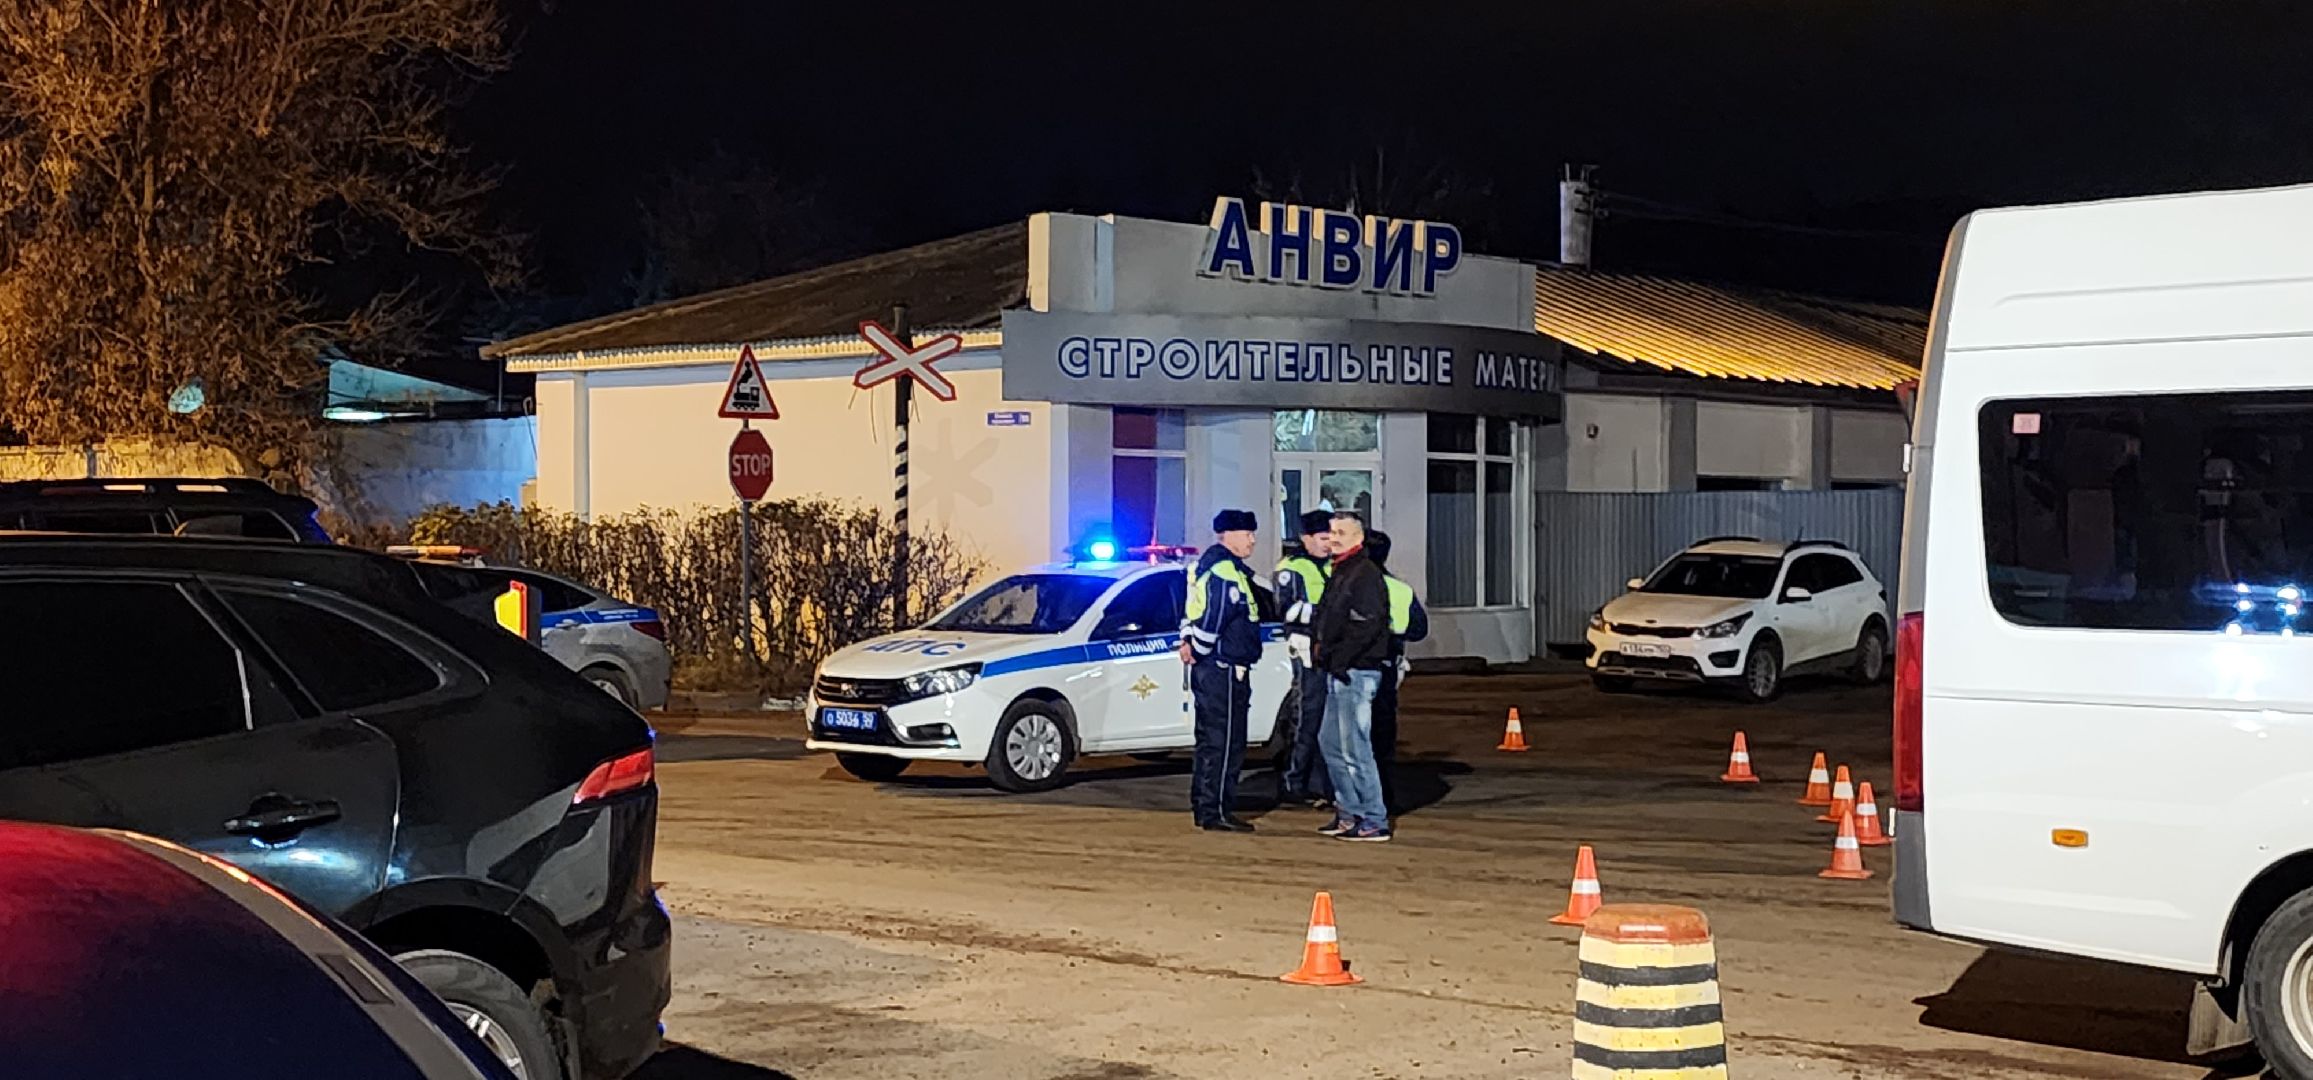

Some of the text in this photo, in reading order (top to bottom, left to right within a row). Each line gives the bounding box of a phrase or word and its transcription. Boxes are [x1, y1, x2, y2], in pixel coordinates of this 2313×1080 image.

[1205, 197, 1462, 297] АНВИР
[1058, 337, 1453, 386] СТРОИТЕЛЬНЫЕ
[732, 454, 771, 476] STOP
[1107, 638, 1168, 656] ПОЛИЦИЯ
